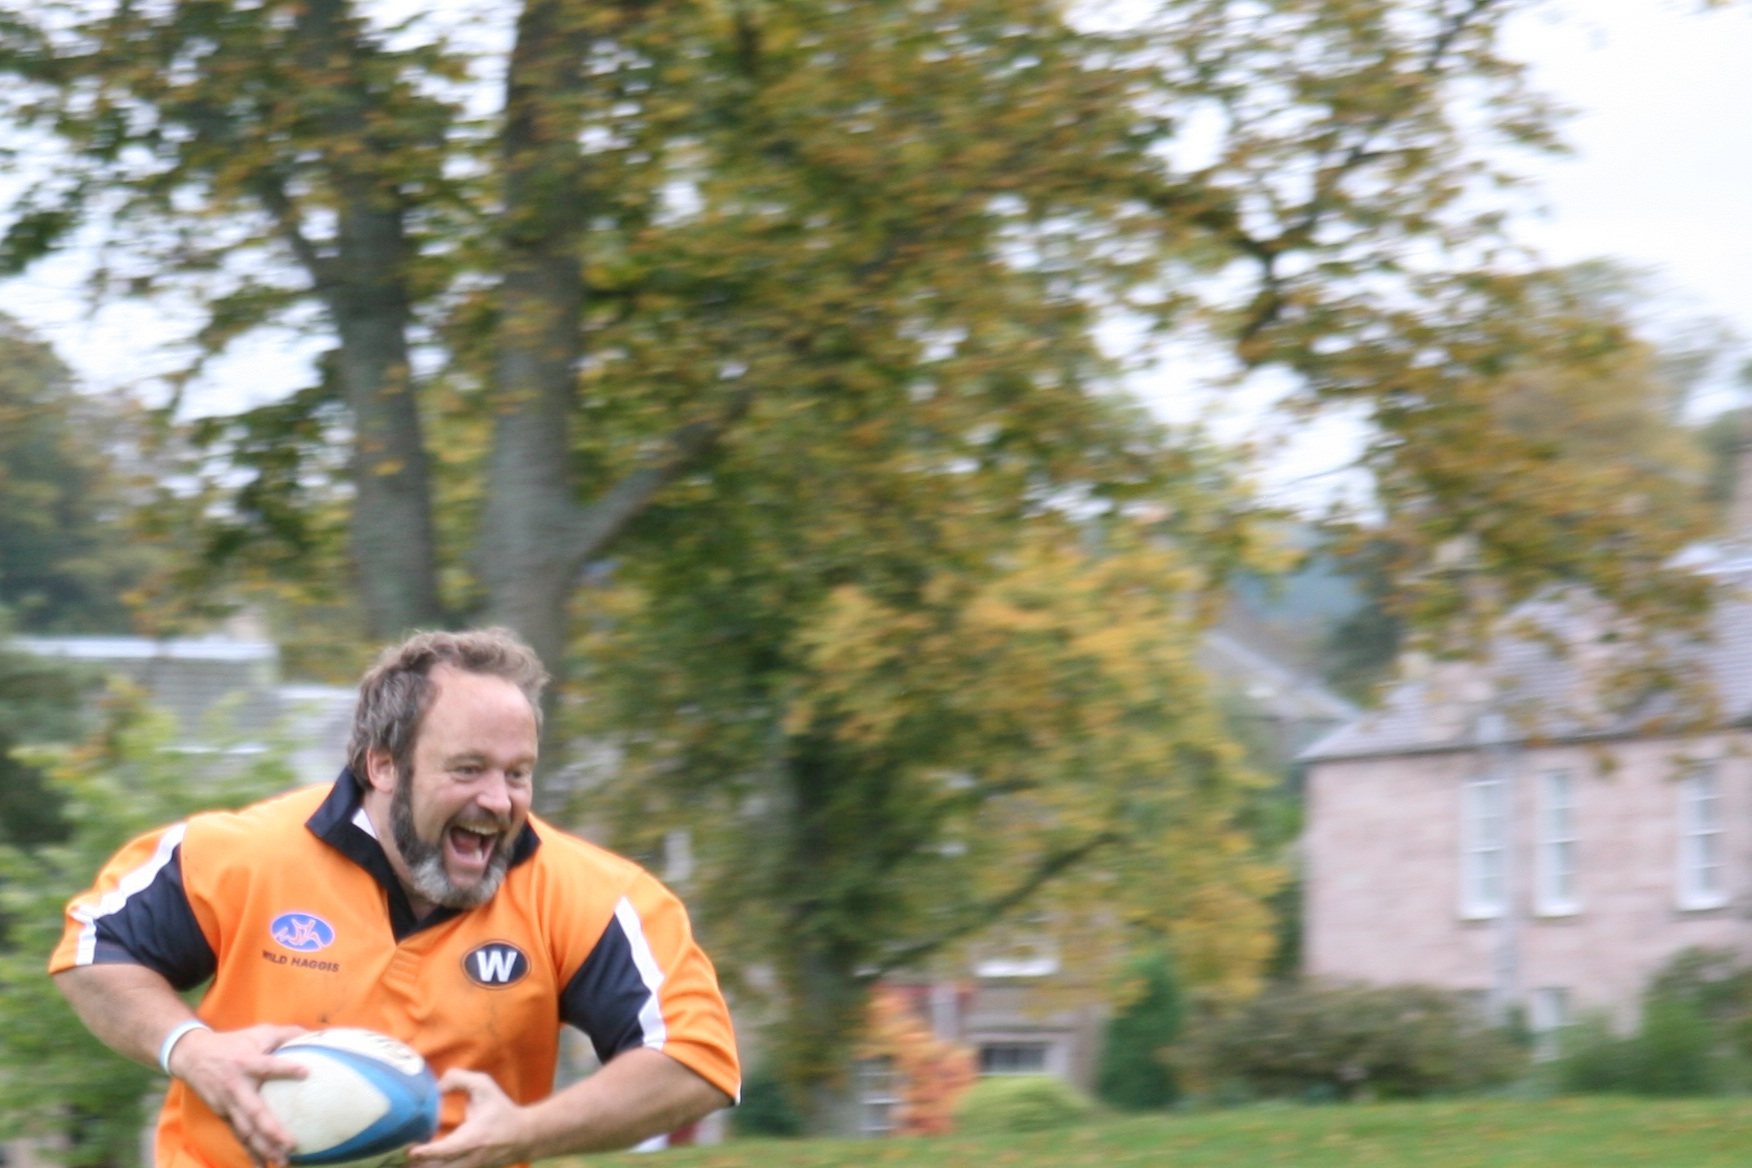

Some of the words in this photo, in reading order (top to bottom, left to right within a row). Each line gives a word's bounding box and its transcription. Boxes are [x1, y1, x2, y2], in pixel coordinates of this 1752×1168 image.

[262, 949, 288, 965] WILD
[291, 957, 340, 973] HAGGIS
[475, 950, 518, 983] W
